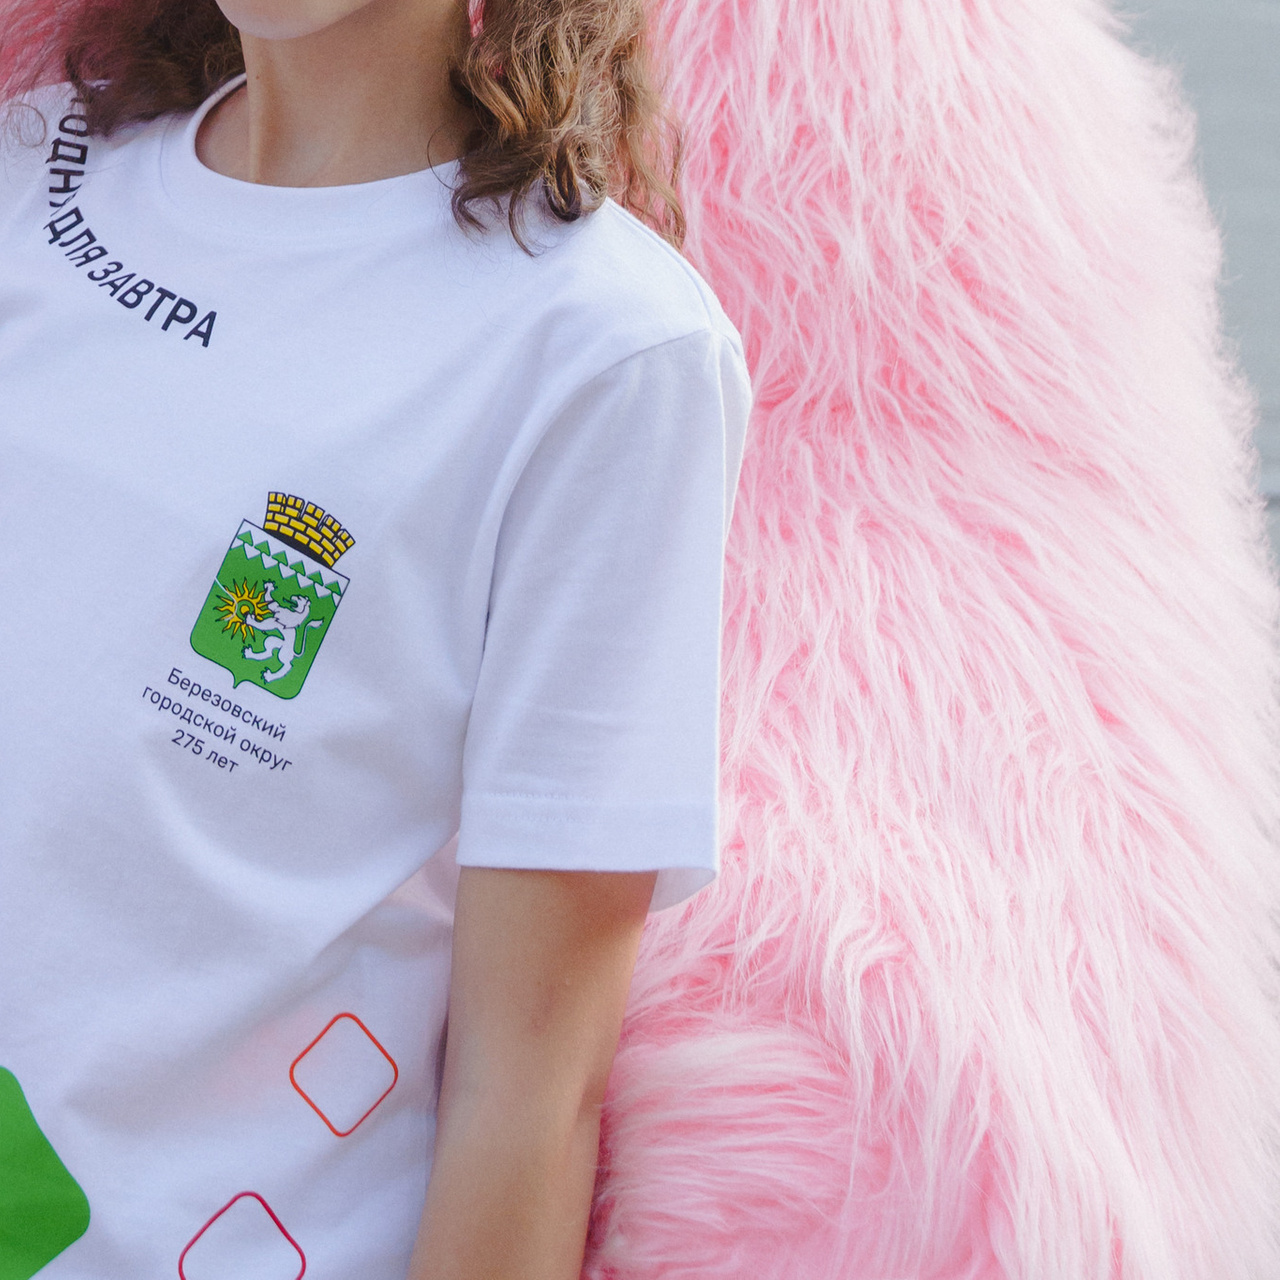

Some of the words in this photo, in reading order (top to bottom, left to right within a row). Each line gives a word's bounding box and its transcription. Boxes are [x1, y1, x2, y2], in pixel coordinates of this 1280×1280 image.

[43, 206, 109, 268] ДЛЯ
[87, 260, 218, 348] ЗАВТРА
[141, 686, 237, 746] городской
[239, 737, 293, 773] округ
[166, 666, 287, 743] Березовский
[170, 729, 204, 756] 275
[205, 749, 240, 774] лет
